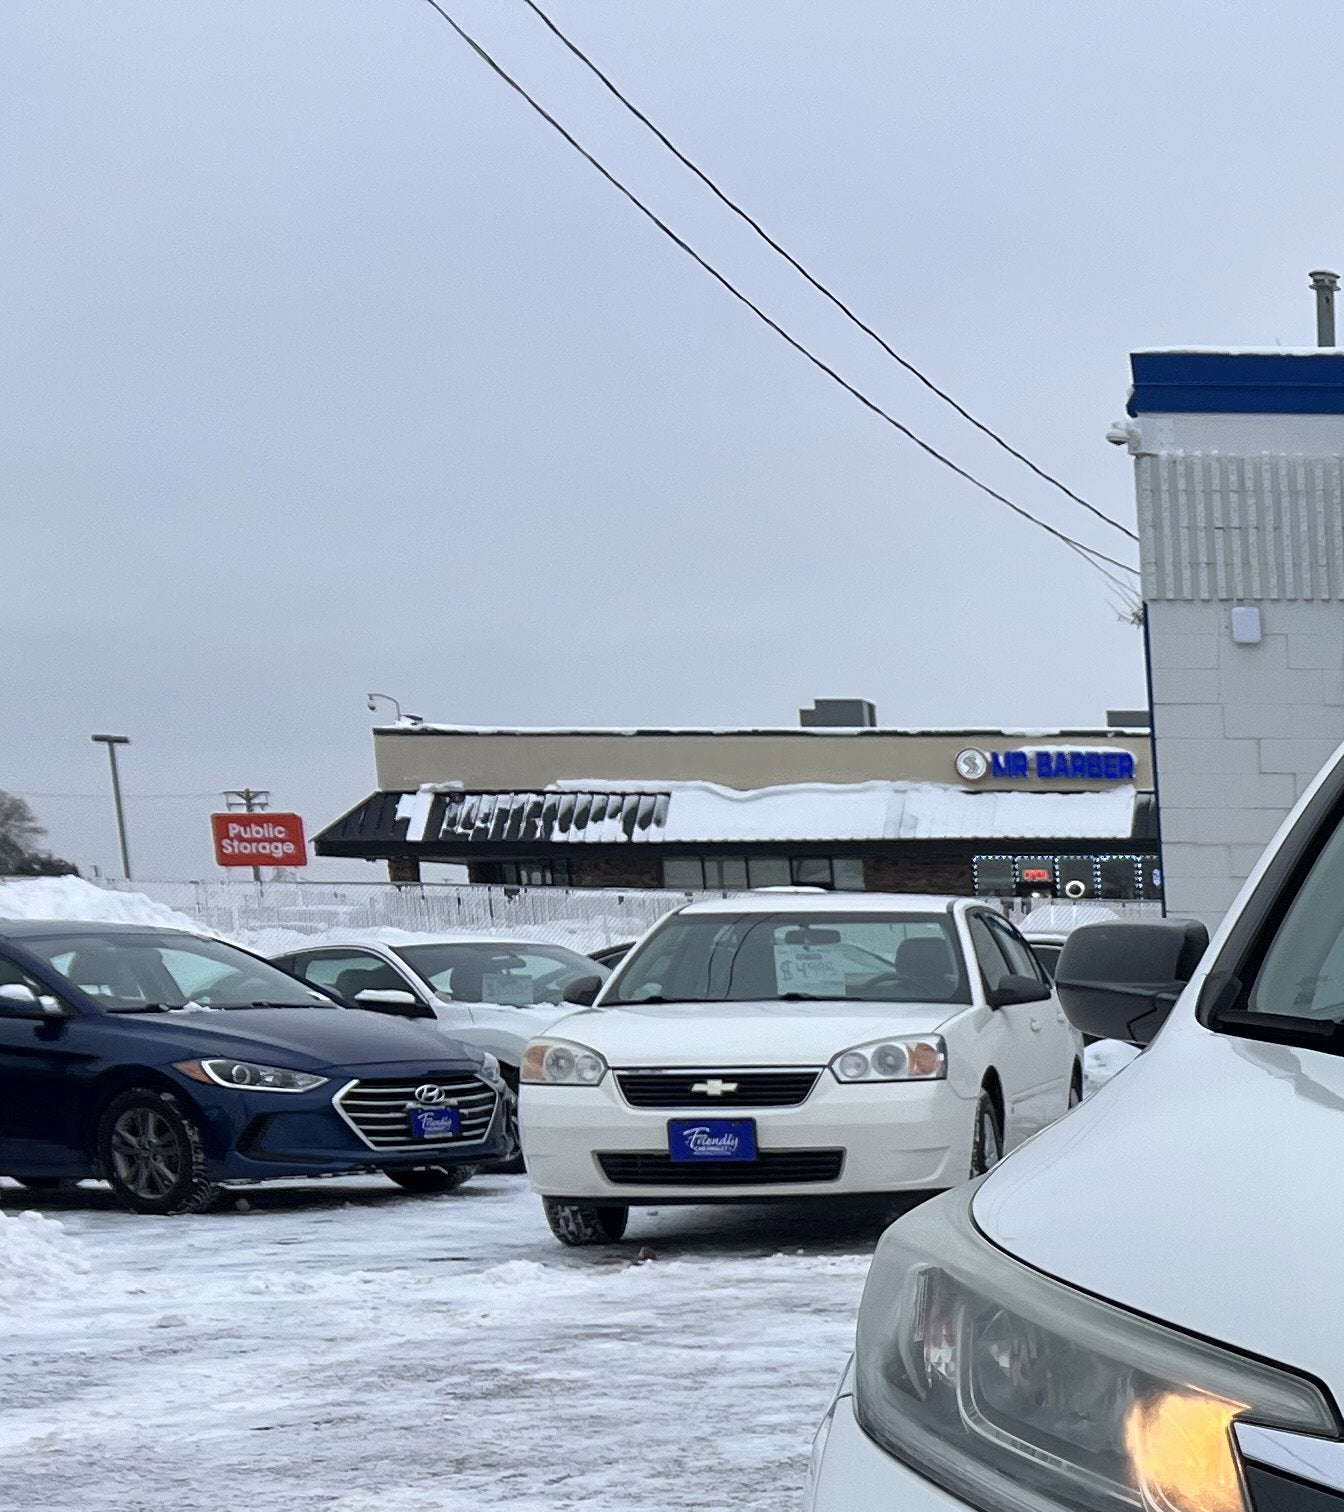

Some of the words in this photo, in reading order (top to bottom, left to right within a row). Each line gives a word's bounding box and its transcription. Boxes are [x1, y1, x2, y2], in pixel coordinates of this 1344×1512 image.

[992, 751, 1029, 778] MR
[1036, 751, 1135, 779] BARBER
[228, 823, 286, 838] Public
[221, 838, 295, 858] Storage
[682, 1126, 739, 1151] Friendly
